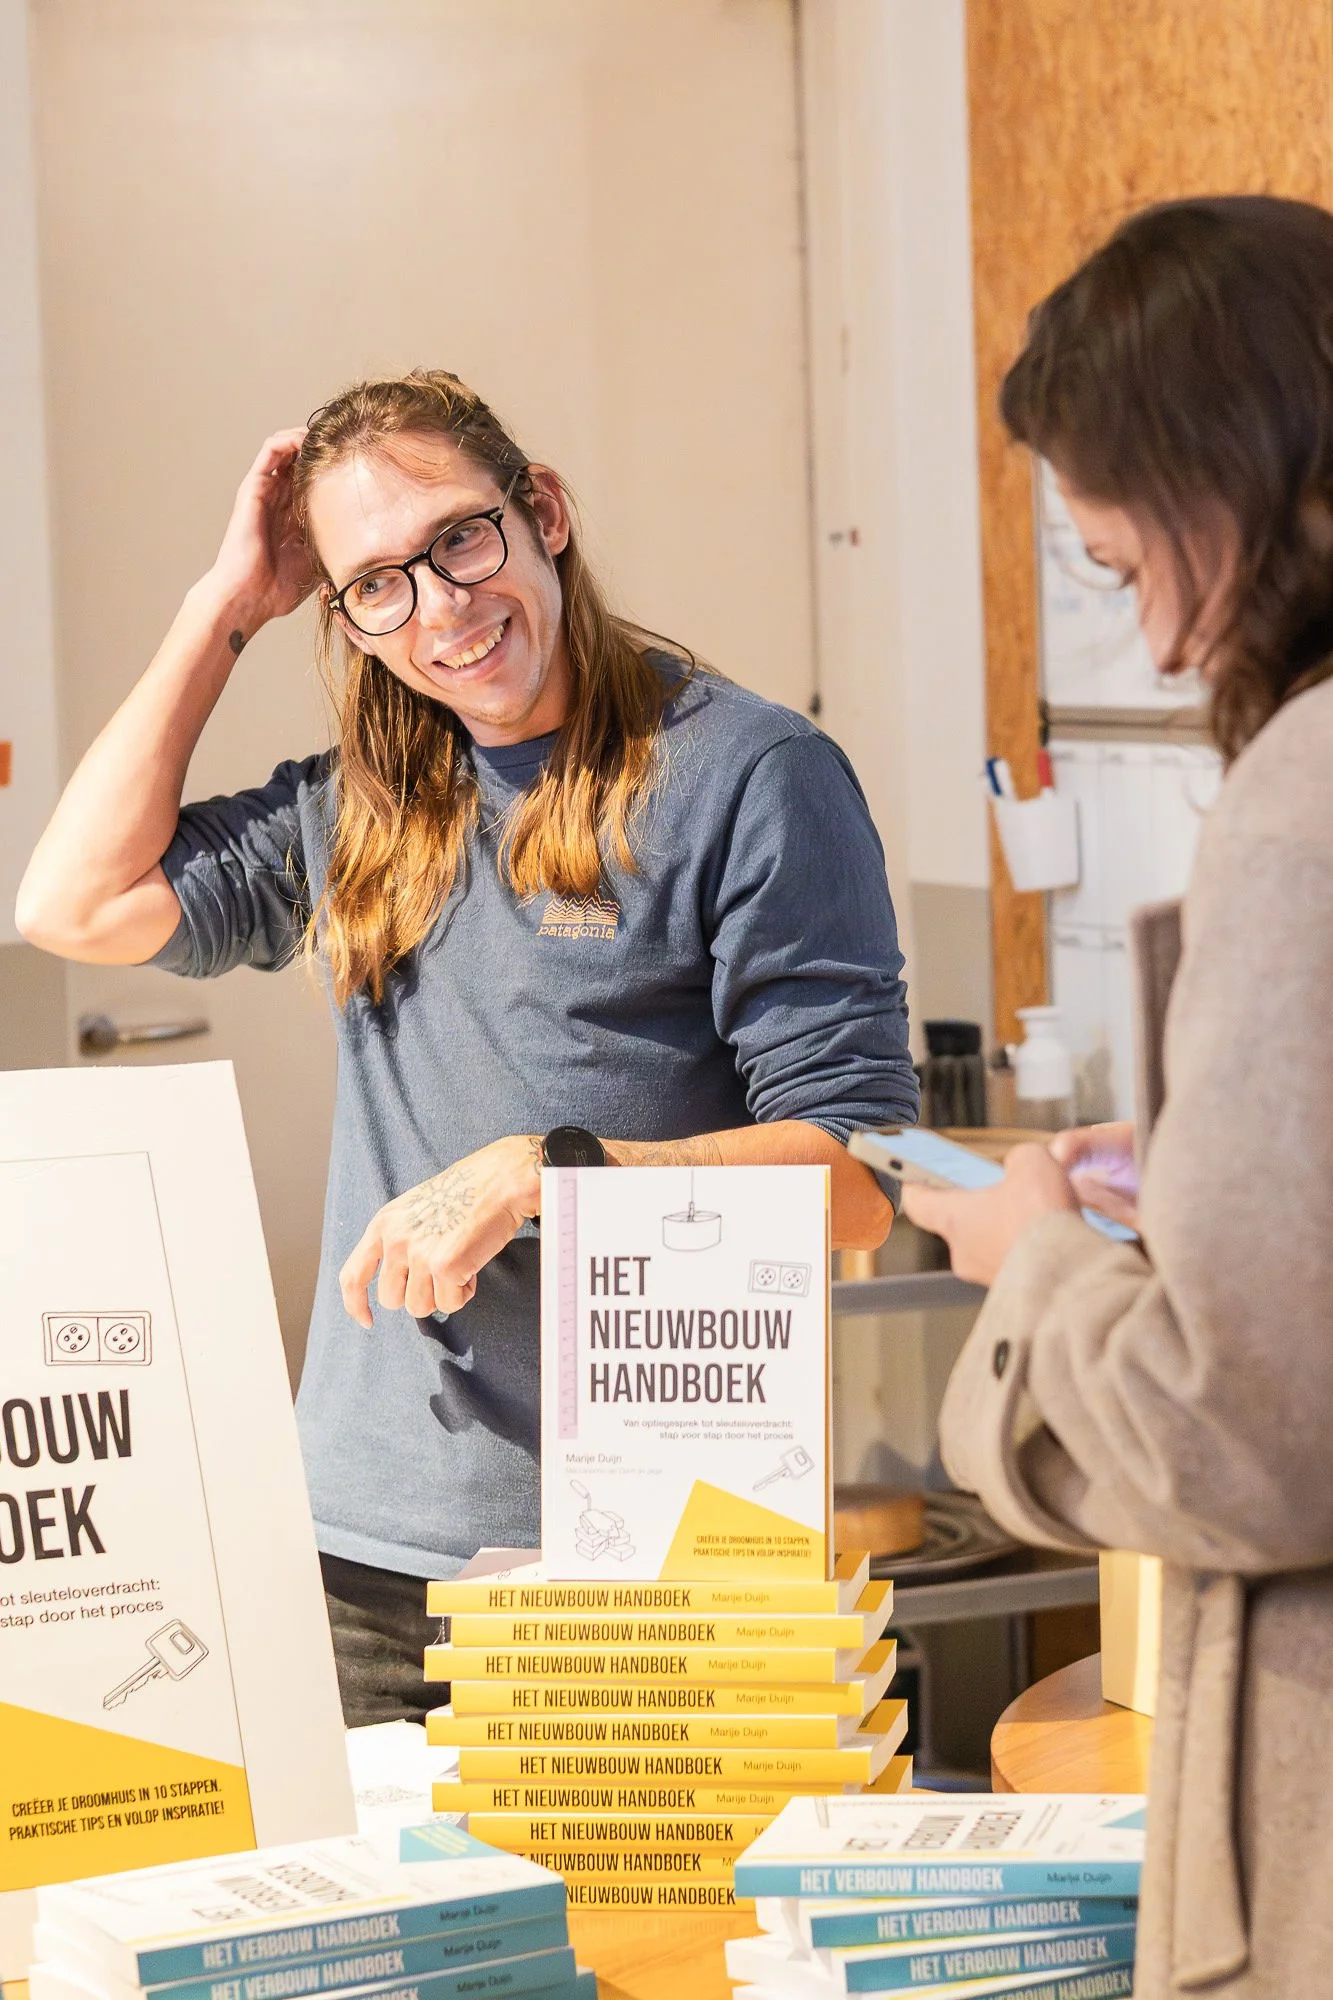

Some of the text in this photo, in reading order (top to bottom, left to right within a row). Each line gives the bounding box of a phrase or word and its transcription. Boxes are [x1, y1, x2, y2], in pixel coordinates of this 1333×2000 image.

[536, 924, 615, 940] patagonia
[590, 1256, 651, 1296] HET
[590, 1310, 792, 1350] NIEUWBOUW
[590, 1363, 766, 1403] HANDBOEK
[0, 1389, 132, 1468] OUW
[623, 1419, 640, 1427] Van
[701, 1419, 713, 1427] tot
[659, 1431, 794, 1441] stap voor stap door het proces
[565, 1453, 622, 1465] Marije Duijn
[693, 1547, 730, 1557] PRAKTISCHE
[733, 1548, 746, 1557] TIPS
[746, 1548, 755, 1557] EN
[20, 1578, 161, 1605] sleuteloverdracht:
[489, 1589, 770, 1608] HET NIEUWBOUW HANDBOEK Marije Duijn
[0, 1598, 164, 1628] stap door het proces
[513, 1623, 794, 1641] HET NIEUWBOUW HANDBOEK Marije Duijn
[486, 1656, 766, 1674] HET NIEUWBOUW HANDBOEK Marije Duijn
[513, 1689, 794, 1708] HET NIEUWBOUW HANDBOEK Marije Duijn
[487, 1722, 768, 1741] HET NIEUWBOUW HANDBOEK Marije Duijn
[520, 1756, 802, 1775] HET NIEUWBOUW HANDBOEK Marije Duijn
[12, 1779, 222, 1818] CREËER JE DROOMHUIS IN 10 STAPPEN.
[493, 1789, 775, 1808] HET NIEUWBOUW HANDBOEK Marije Duijn
[9, 1800, 225, 1841] PRAKTISCHE TIPS EN VOLOP INSPIRATIE!
[530, 1822, 557, 1841] HET
[561, 1822, 651, 1841] NIEUWBOUW
[655, 1822, 733, 1841] HANDBOEK
[624, 1853, 701, 1872] HANDBOEK
[800, 1869, 832, 1893] HET
[834, 1868, 912, 1892] VERBOUW
[916, 1867, 1004, 1892] HANDBOEK
[566, 1885, 736, 1905] NIEUWBOUW HANDBOEK
[877, 1900, 1081, 1939] HET VERBOUW HANDBOEK
[203, 1942, 234, 1968] HET
[236, 1928, 314, 1963] VERBOUW
[316, 1914, 400, 1949] HANDBOEK
[909, 1937, 1108, 1981] HET VERBOUW HANDBOEK
[211, 1980, 241, 2000] HET
[244, 1966, 320, 2000] VERBOUW
[322, 1949, 405, 1987] HANDBOEK
